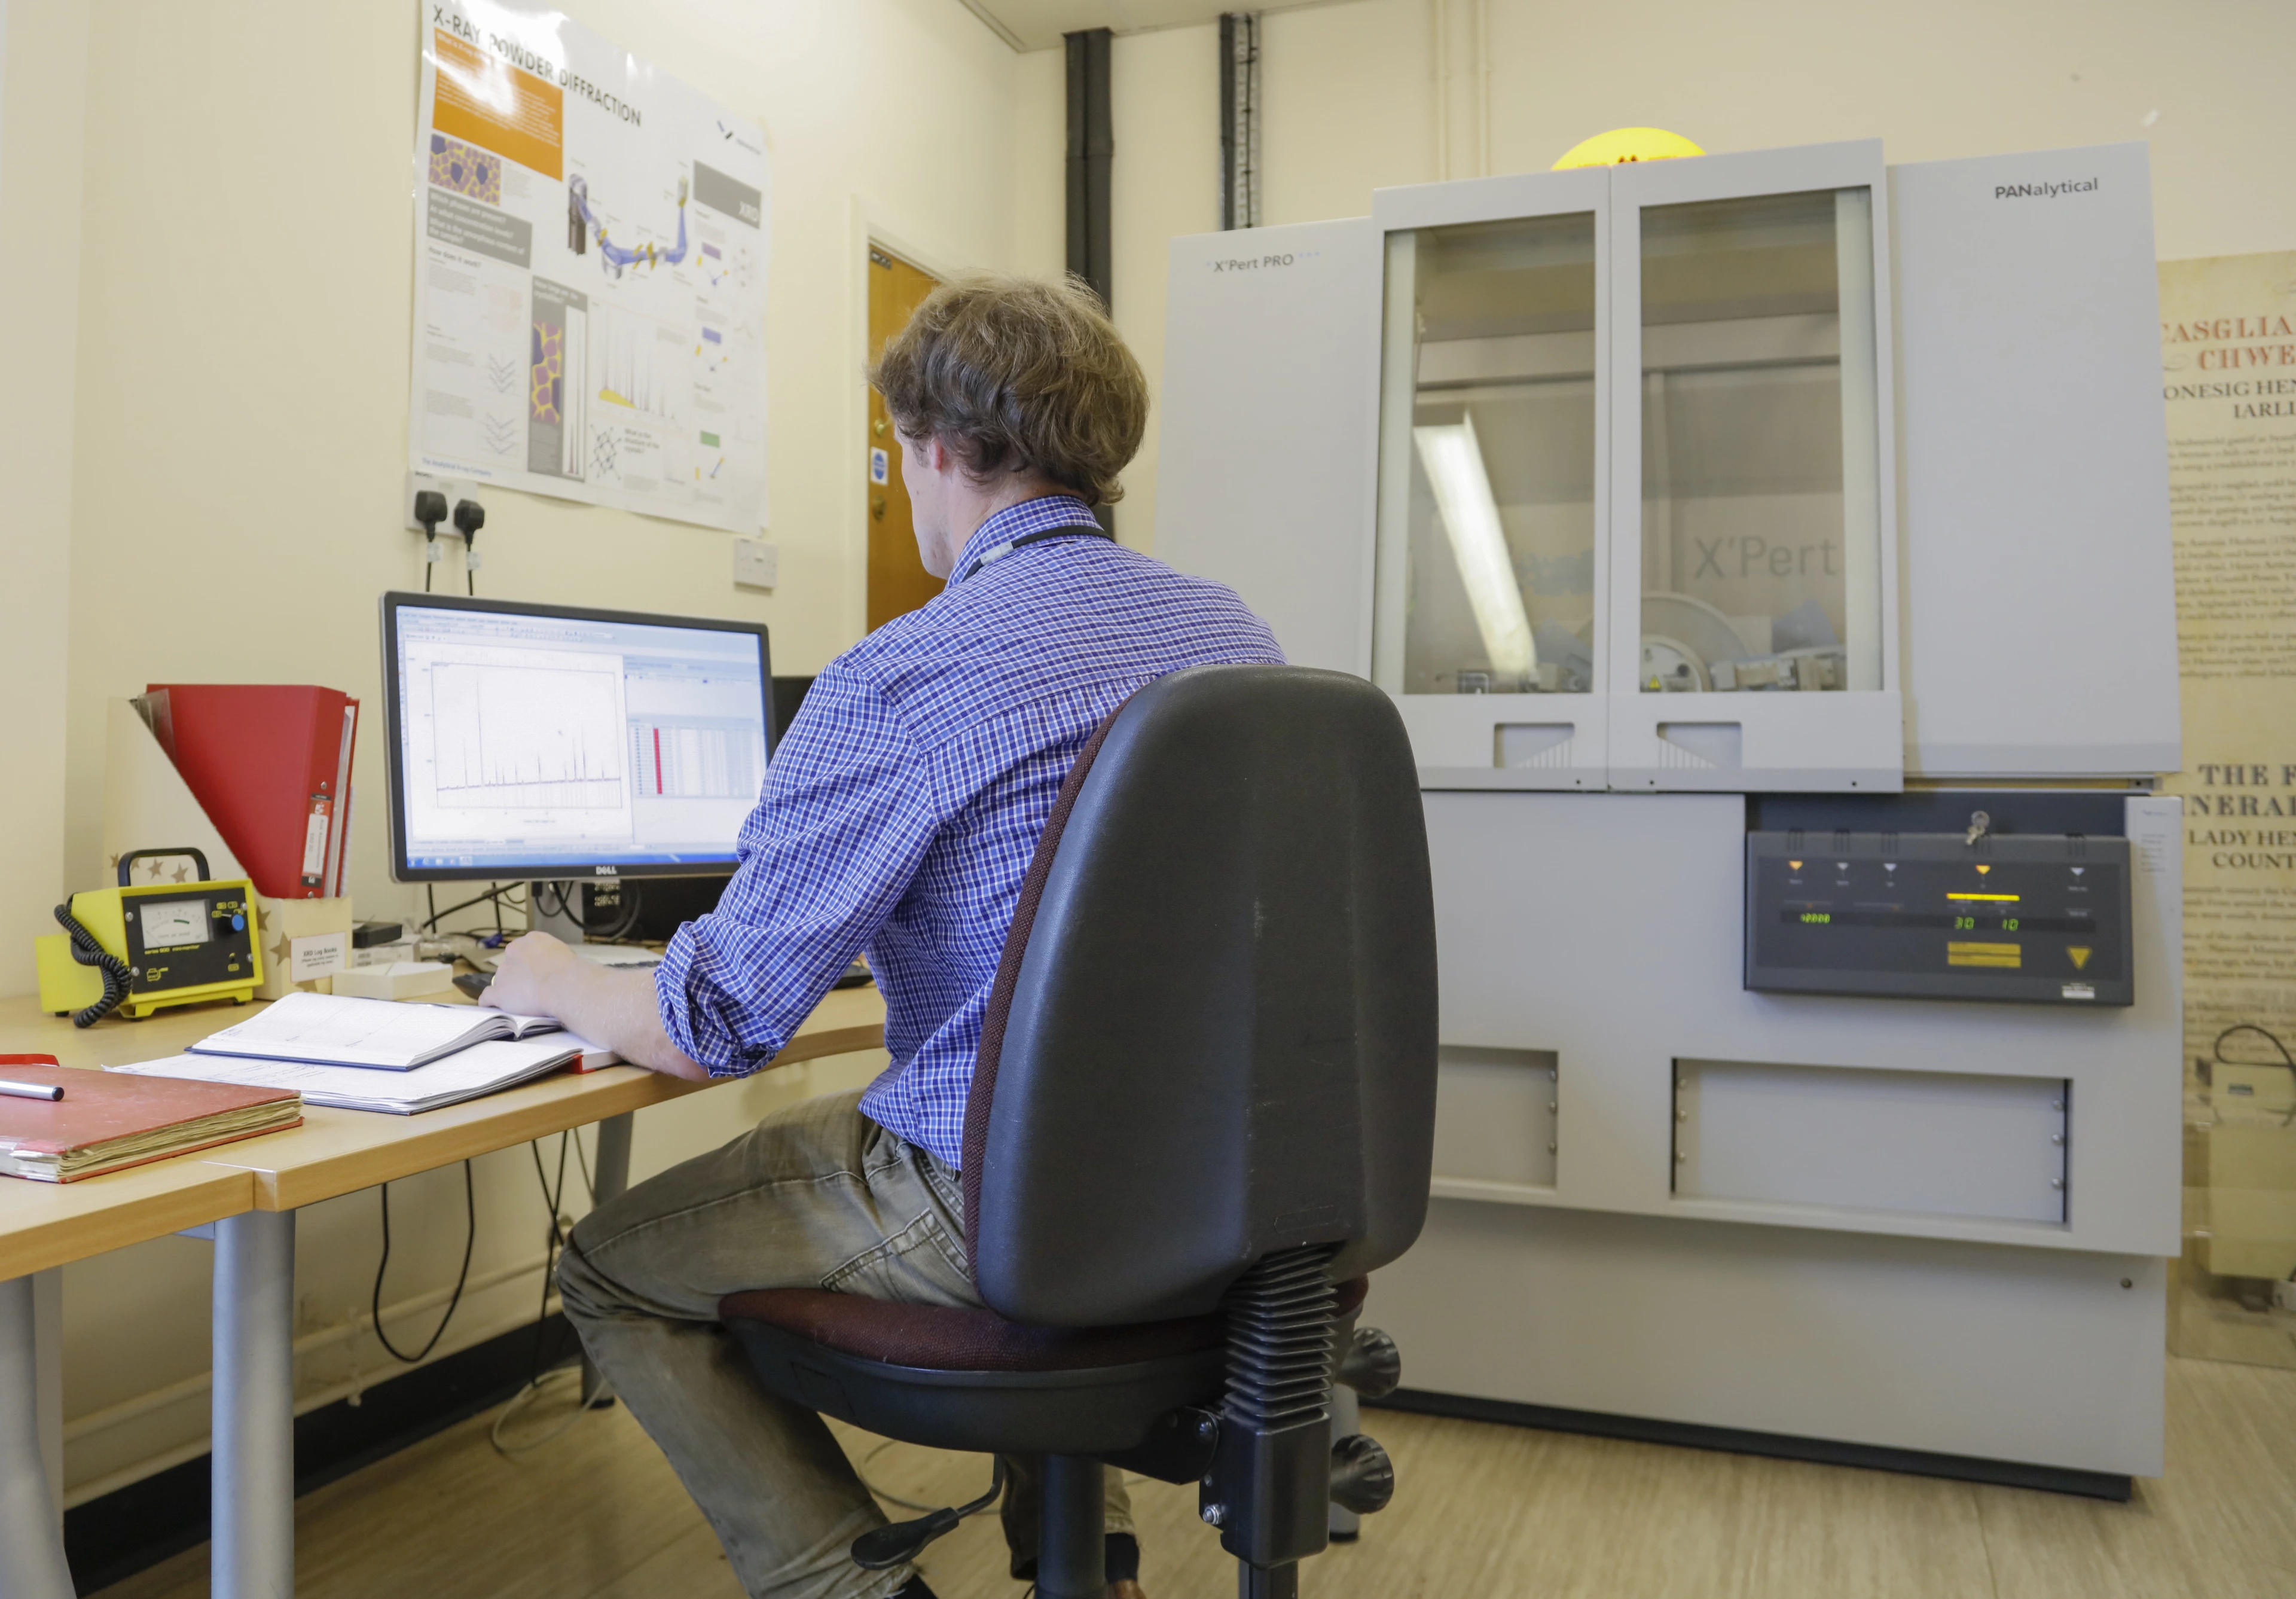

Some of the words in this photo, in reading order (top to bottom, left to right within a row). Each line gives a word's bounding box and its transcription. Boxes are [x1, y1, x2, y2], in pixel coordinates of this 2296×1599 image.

[433, 4, 481, 43] X-RAY
[489, 32, 554, 80] POWDER
[559, 68, 642, 127] DIFFRACTION
[1995, 178, 2098, 199] PANalytical
[1263, 254, 1294, 267] PRO
[1694, 536, 1837, 579] X'Pert
[2198, 763, 2269, 786] THE
[2189, 828, 2250, 846] LADY
[596, 865, 617, 875] DELL
[1955, 917, 1974, 929] 30
[2002, 918, 2019, 930] 10
